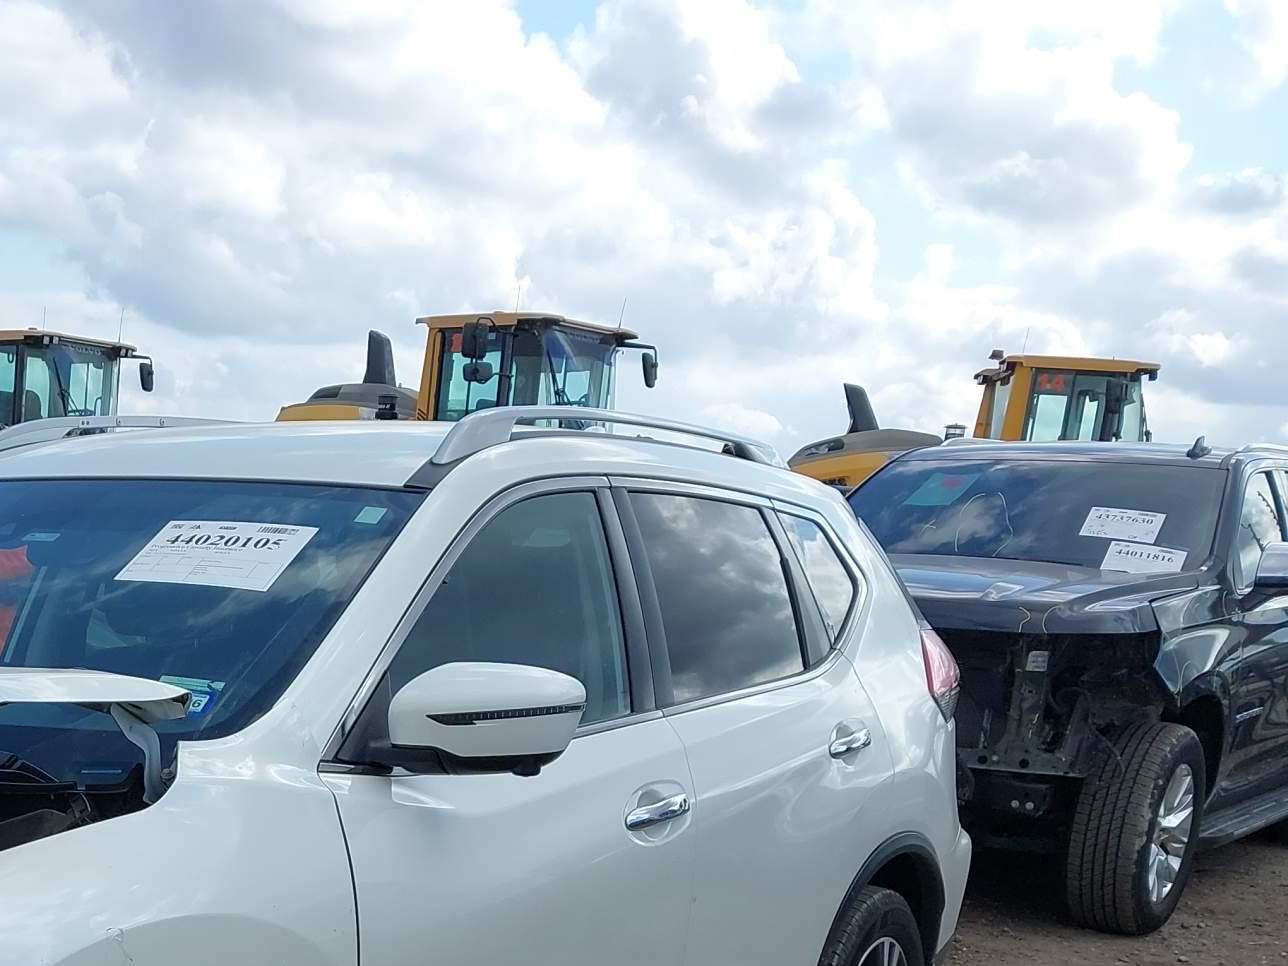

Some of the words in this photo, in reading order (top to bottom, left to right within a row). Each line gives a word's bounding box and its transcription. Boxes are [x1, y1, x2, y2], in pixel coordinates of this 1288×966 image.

[1095, 513, 1154, 525] 43737630
[166, 533, 288, 551] 44020105
[1115, 548, 1174, 563] 44011816
